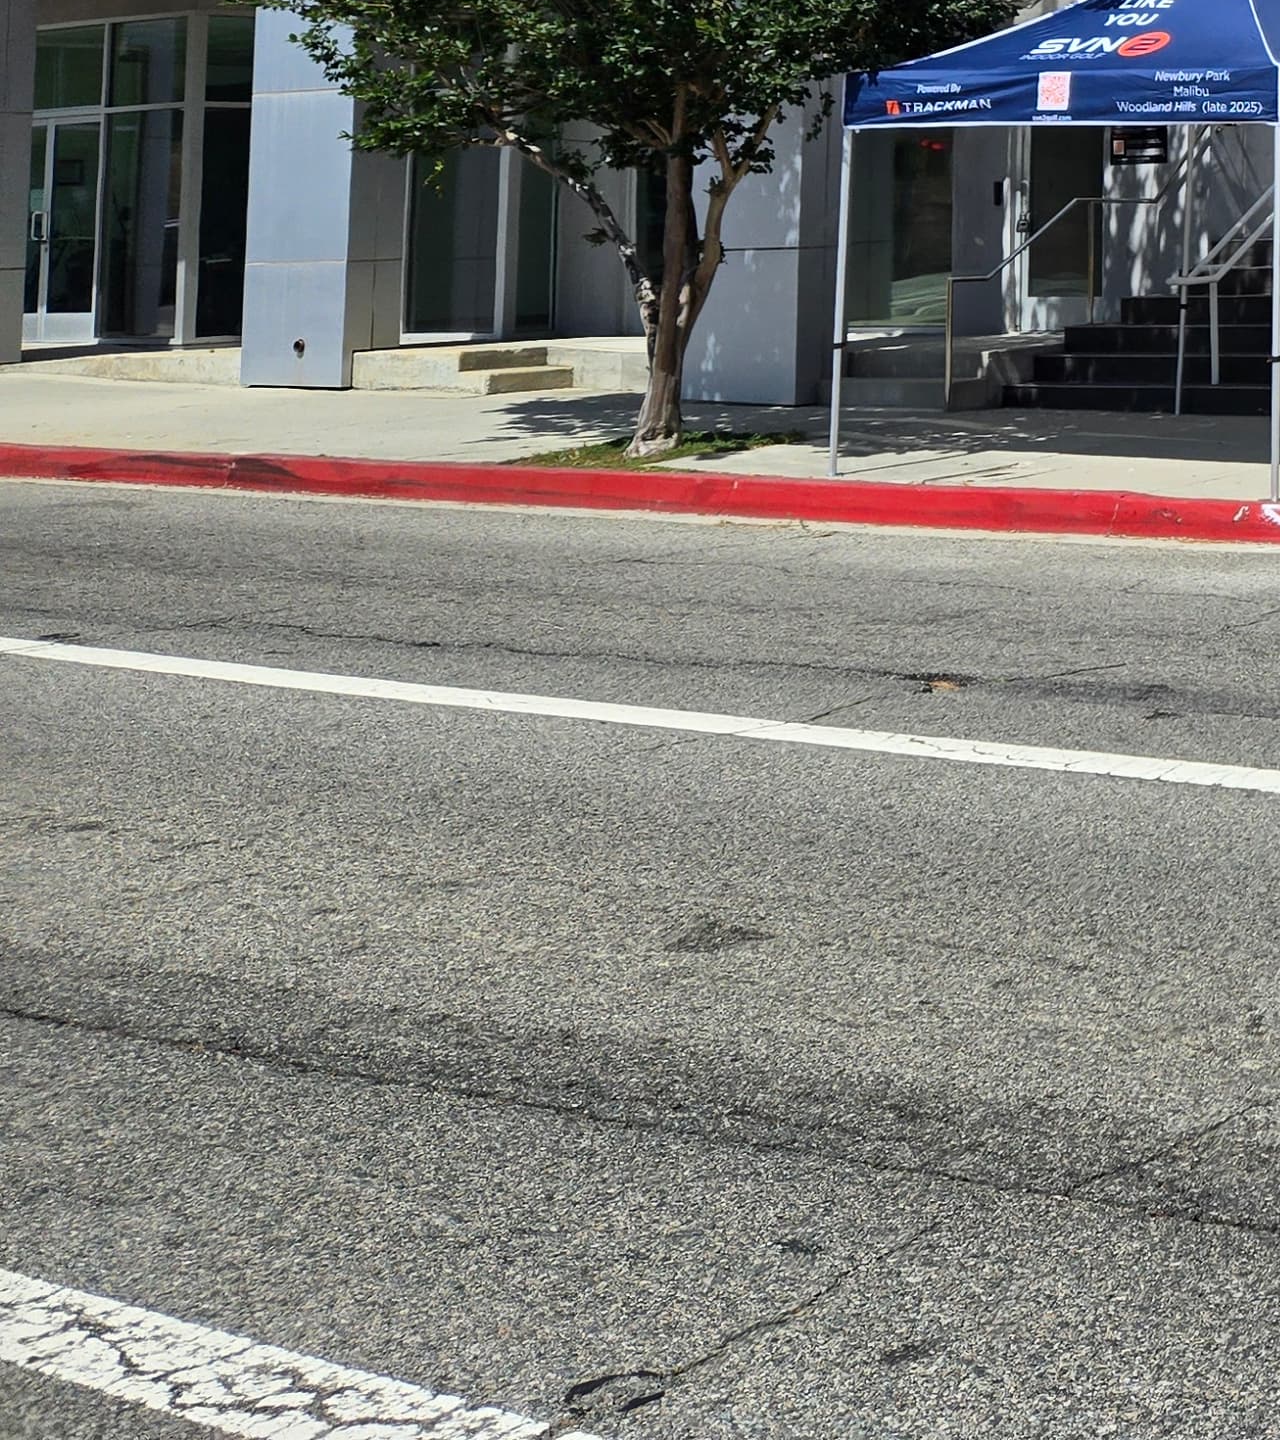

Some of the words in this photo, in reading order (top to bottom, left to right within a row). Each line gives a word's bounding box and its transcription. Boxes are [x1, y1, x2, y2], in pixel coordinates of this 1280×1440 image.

[1104, 13, 1159, 26] YOU
[1154, 71, 1202, 83] Newbury
[1205, 70, 1230, 81] Park
[1173, 86, 1210, 97] Malibu
[902, 99, 992, 113] TRACKMAN
[1116, 101, 1172, 113] Woodland
[1174, 101, 1196, 112] Hills
[1202, 102, 1227, 114] (late
[1229, 102, 1263, 115] 2025)
